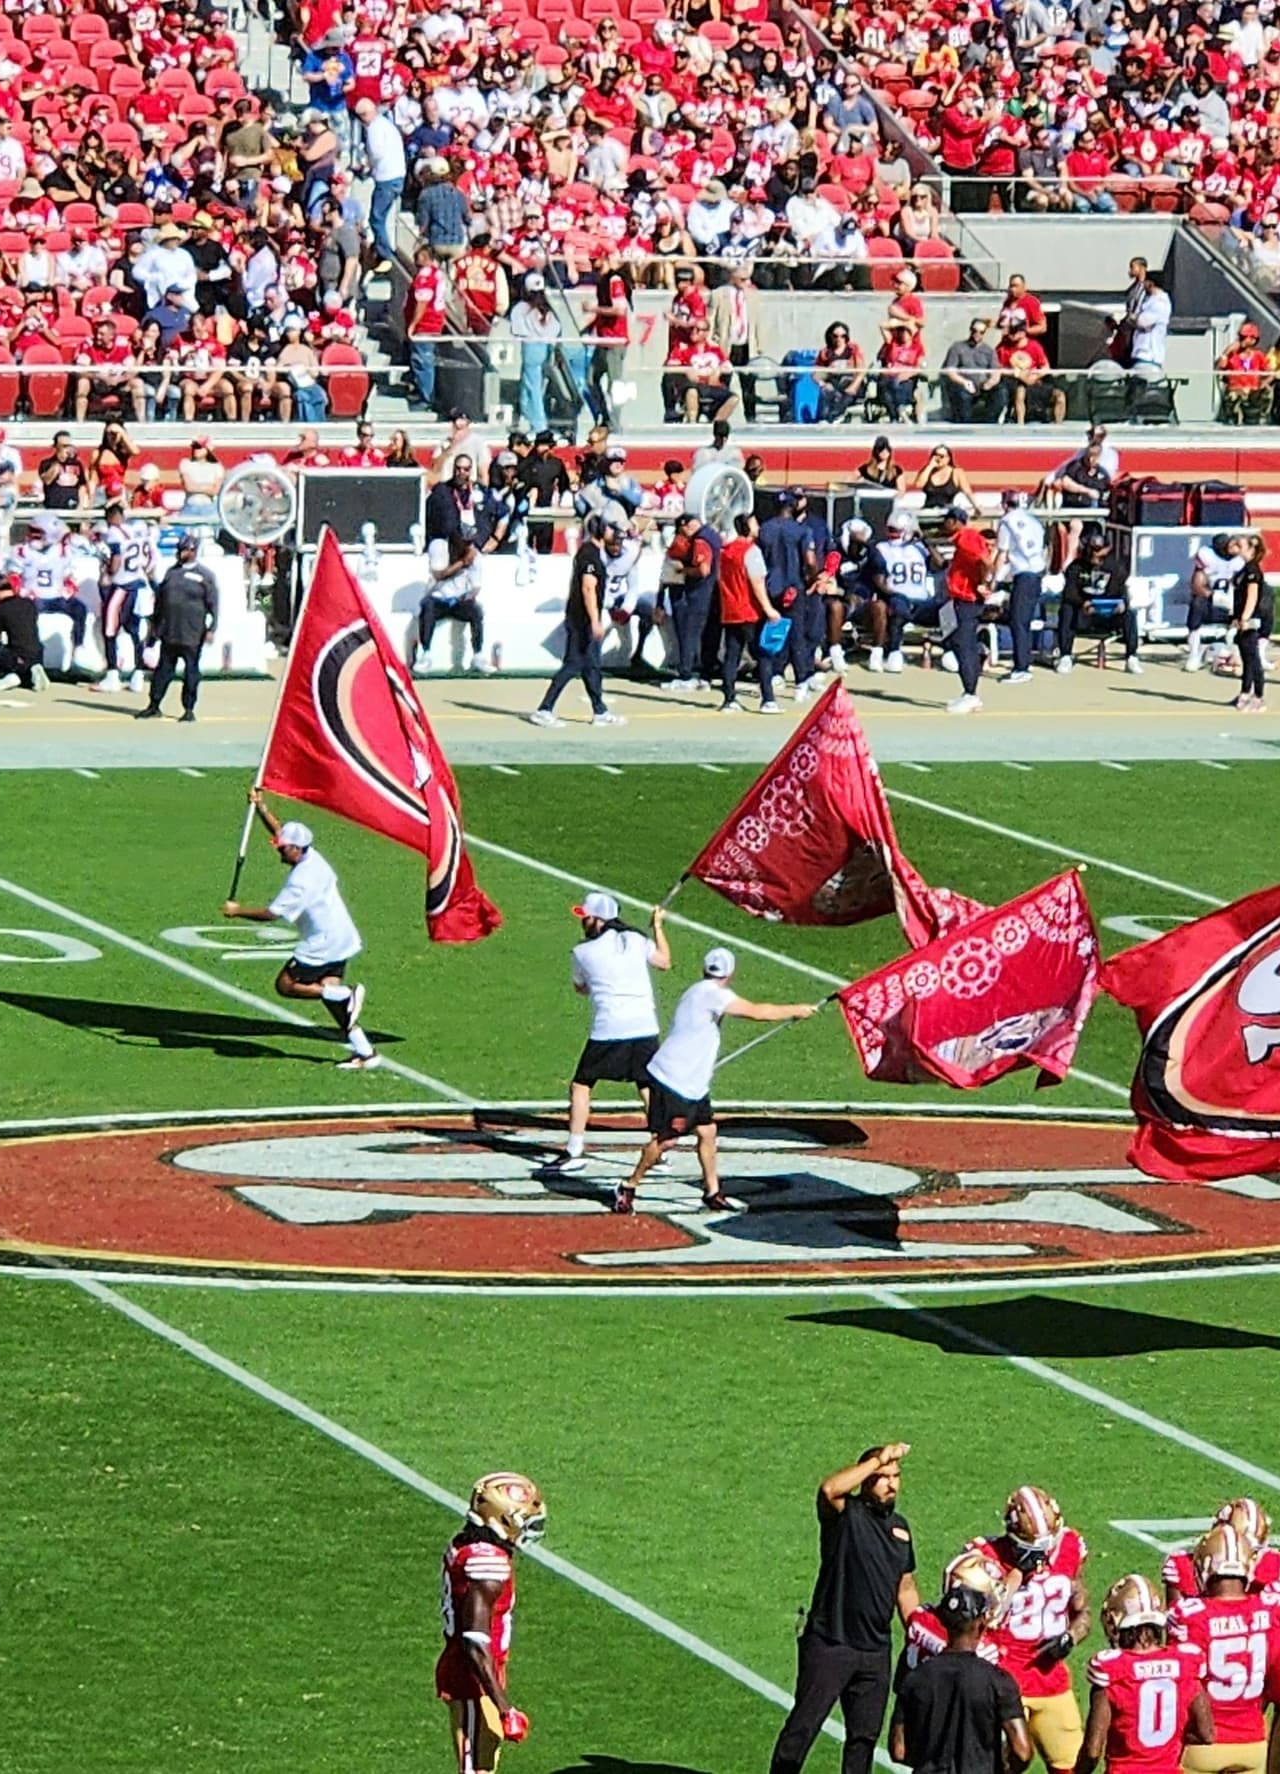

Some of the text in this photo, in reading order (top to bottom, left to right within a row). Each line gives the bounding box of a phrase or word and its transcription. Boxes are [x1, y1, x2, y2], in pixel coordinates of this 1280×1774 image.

[635, 315, 656, 345] 7
[891, 562, 924, 585] 96
[1009, 1574, 1072, 1640] 82
[1207, 1632, 1269, 1702] 51
[1138, 1677, 1177, 1749] 0
